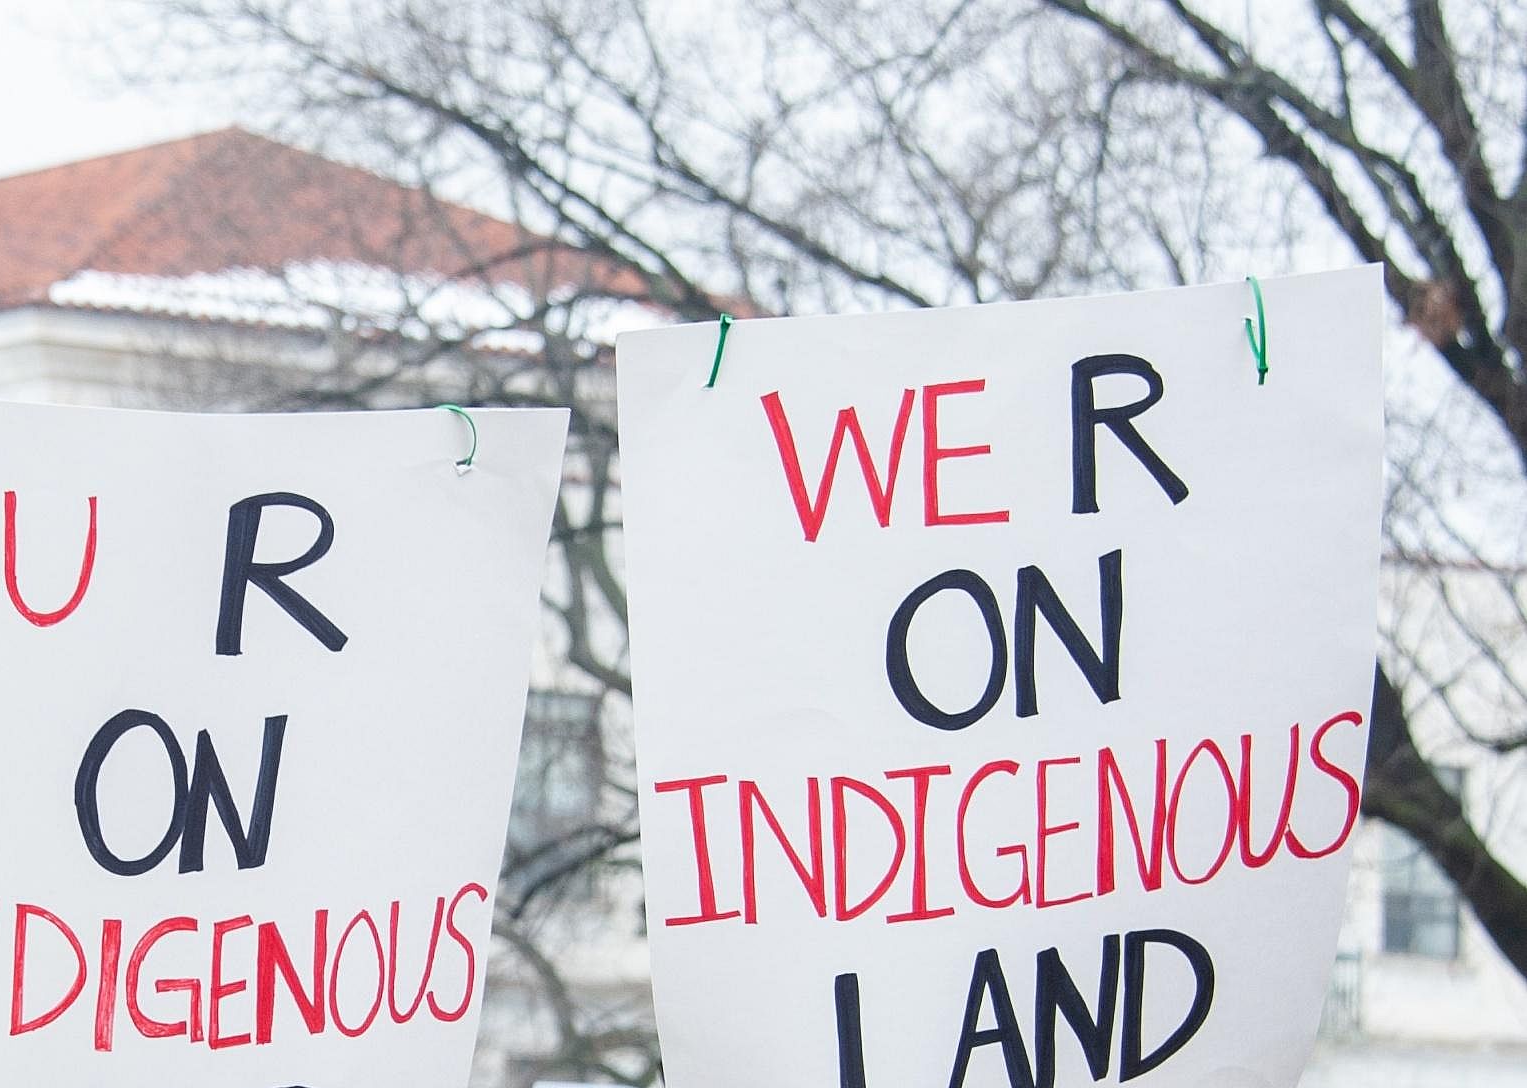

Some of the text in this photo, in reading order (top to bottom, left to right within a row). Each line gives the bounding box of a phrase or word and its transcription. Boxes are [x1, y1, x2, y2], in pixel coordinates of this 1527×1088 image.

[761, 353, 1190, 543] WE R
[4, 490, 349, 657] U R
[886, 549, 1123, 732] ON
[74, 709, 288, 877] ON
[654, 711, 1363, 927] INDIGENOUS
